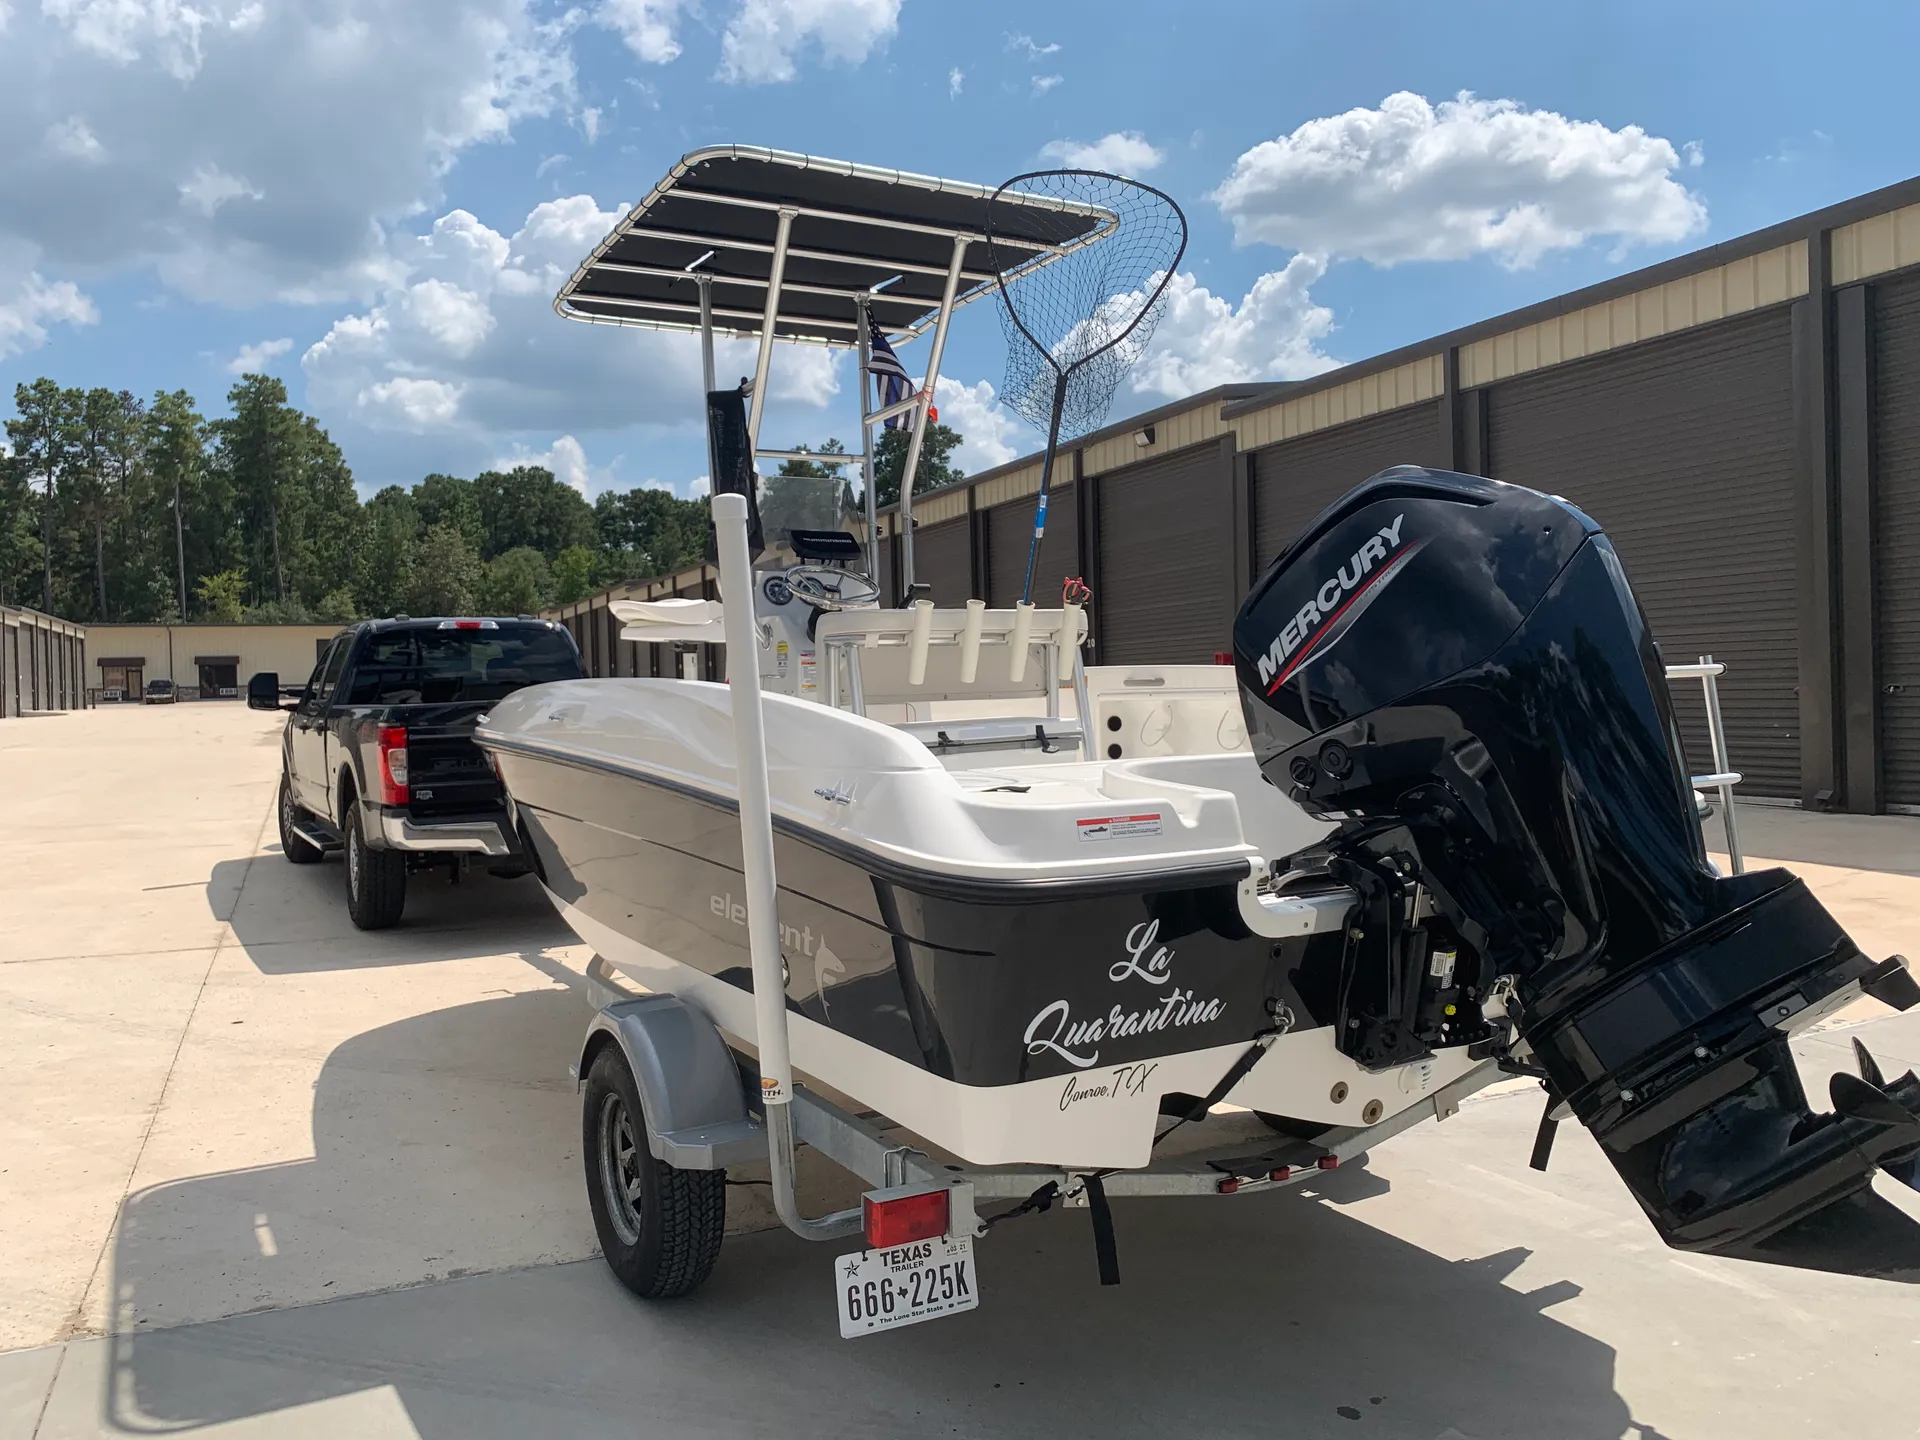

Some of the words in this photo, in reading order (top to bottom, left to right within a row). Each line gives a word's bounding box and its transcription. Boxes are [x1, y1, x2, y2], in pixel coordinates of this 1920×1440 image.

[1257, 513, 1404, 686] MERCURY
[710, 893, 813, 956] elent
[1108, 918, 1175, 984] La
[1023, 987, 1227, 1067] Quarantina
[880, 1243, 932, 1267] TEXAS
[890, 1260, 924, 1273] TRAILER
[848, 1277, 895, 1321] 666
[909, 1260, 970, 1308] 225K
[893, 1313, 910, 1321] Lone
[911, 1309, 926, 1317] Star
[926, 1305, 944, 1313] State
